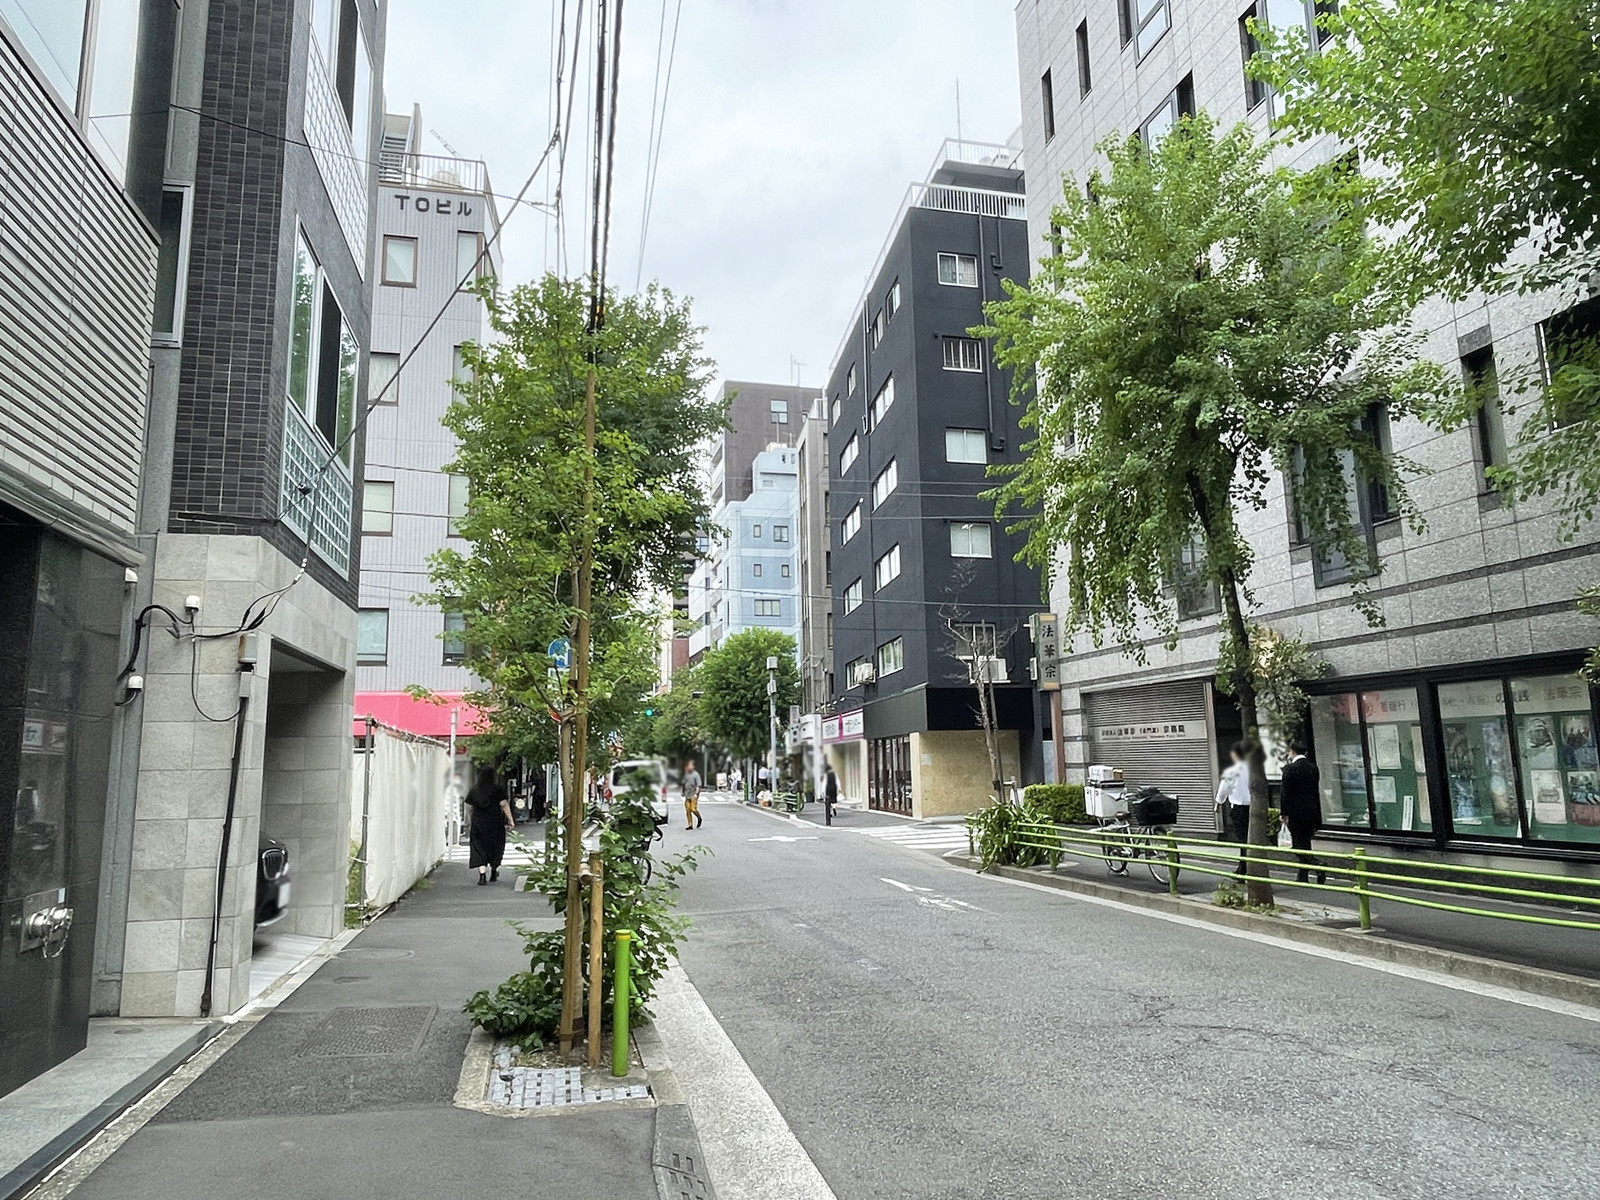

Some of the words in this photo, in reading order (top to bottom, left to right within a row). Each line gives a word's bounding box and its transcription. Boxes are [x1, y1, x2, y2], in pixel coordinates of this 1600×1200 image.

[394, 194, 472, 216] TOビル
[1042, 624, 1056, 678] 法華宗
